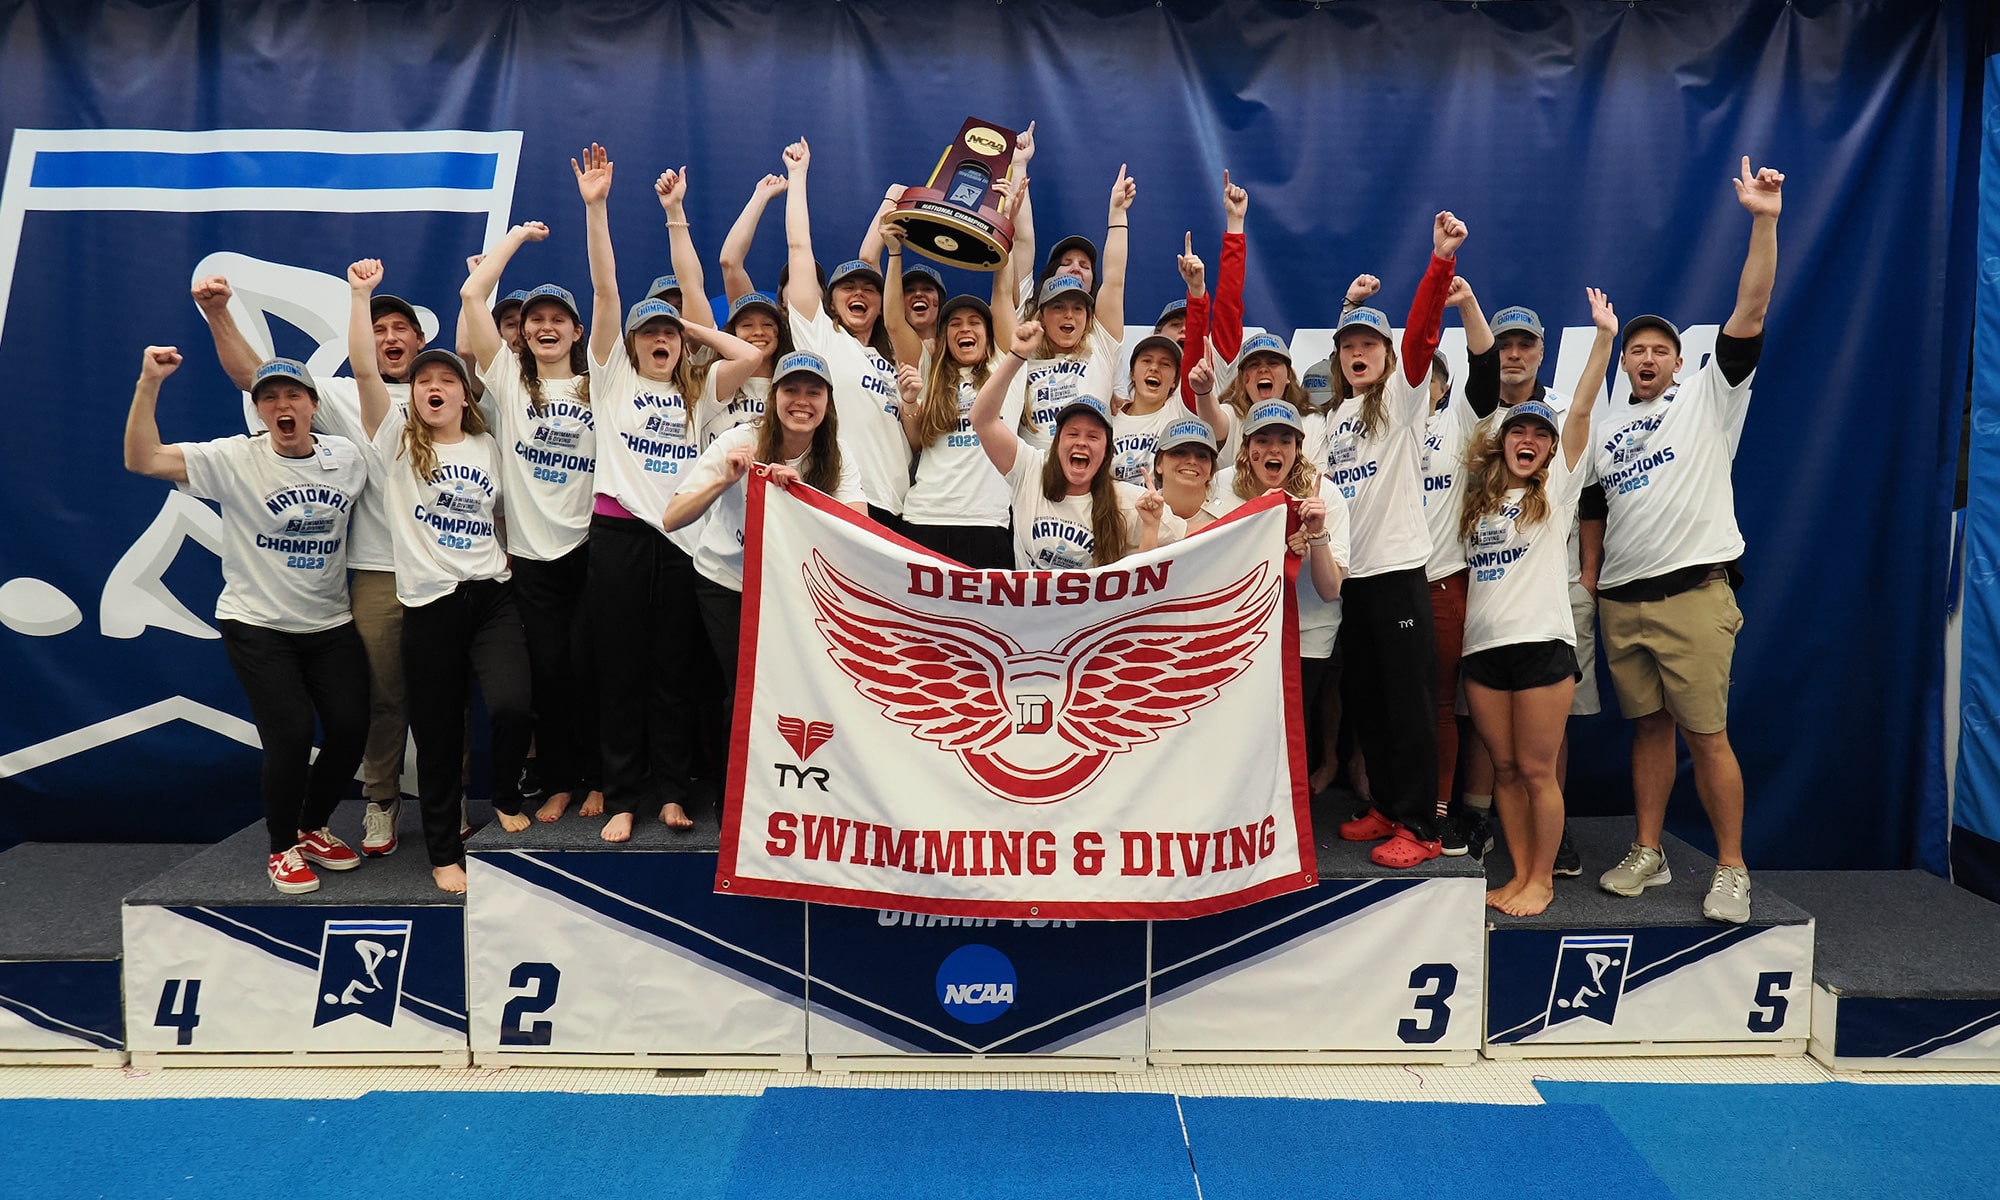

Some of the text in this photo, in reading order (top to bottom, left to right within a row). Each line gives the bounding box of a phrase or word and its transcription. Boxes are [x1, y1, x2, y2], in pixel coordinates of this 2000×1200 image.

[967, 134, 1004, 153] NCAA
[921, 203, 989, 231] NATIONAL CHAMPION
[782, 356, 824, 372] CHAMPIONS
[1252, 406, 1294, 422] CHAMPIONS
[947, 434, 981, 448] 2023
[1169, 424, 1210, 440] CHAMPIONS
[533, 466, 568, 485] 2023
[644, 458, 678, 475] 2023
[1332, 460, 1378, 486] MPIONS
[1340, 485, 1356, 499] 23
[1619, 474, 1650, 495] 2023
[266, 488, 350, 515] NATIONAL
[437, 533, 473, 550] 2023
[1032, 521, 1096, 554] NATIONA
[286, 556, 326, 570] 2023
[908, 560, 1172, 608] DENISON
[1476, 567, 1506, 582] 2023
[1398, 619, 1414, 629] TYR
[1016, 694, 1053, 734] D
[774, 763, 830, 792] TYR
[765, 812, 1276, 877] SWIMMING & DIVING
[500, 962, 560, 1046] 2
[943, 983, 1014, 1005] NCAA
[1397, 963, 1459, 1044] 3
[1747, 971, 1792, 1033] 5
[153, 979, 201, 1046] 4
